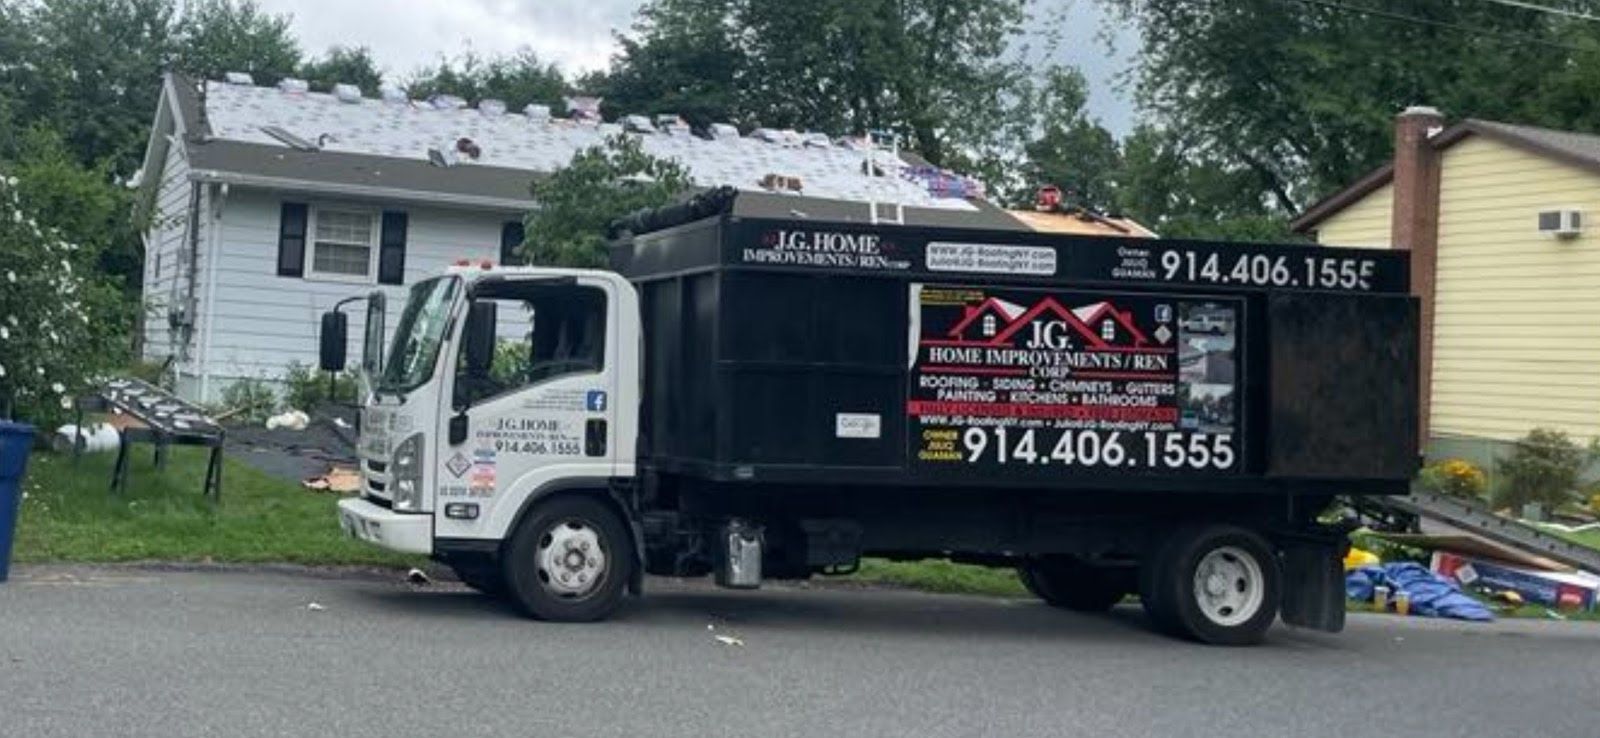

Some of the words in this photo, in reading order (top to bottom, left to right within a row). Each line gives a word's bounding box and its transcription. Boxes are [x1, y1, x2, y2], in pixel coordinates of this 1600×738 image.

[773, 230, 812, 252] J.G.
[813, 232, 881, 255] HOME
[1161, 250, 1375, 290] 914.406.1555
[1026, 320, 1074, 351] J.G.
[929, 347, 981, 364] HOME
[985, 348, 1122, 369] IMPROVEMENTS
[1134, 355, 1169, 370] REN
[919, 376, 980, 390] ROOFING
[992, 378, 1036, 391] SIDING
[1049, 380, 1113, 394] CHIMNEYS
[1125, 382, 1176, 396] GUTTERS
[937, 389, 997, 403] PAINTING
[1009, 391, 1069, 405] KITCHENS
[1082, 393, 1159, 407] BATHROOMS
[963, 427, 1236, 470] 914.406.1555
